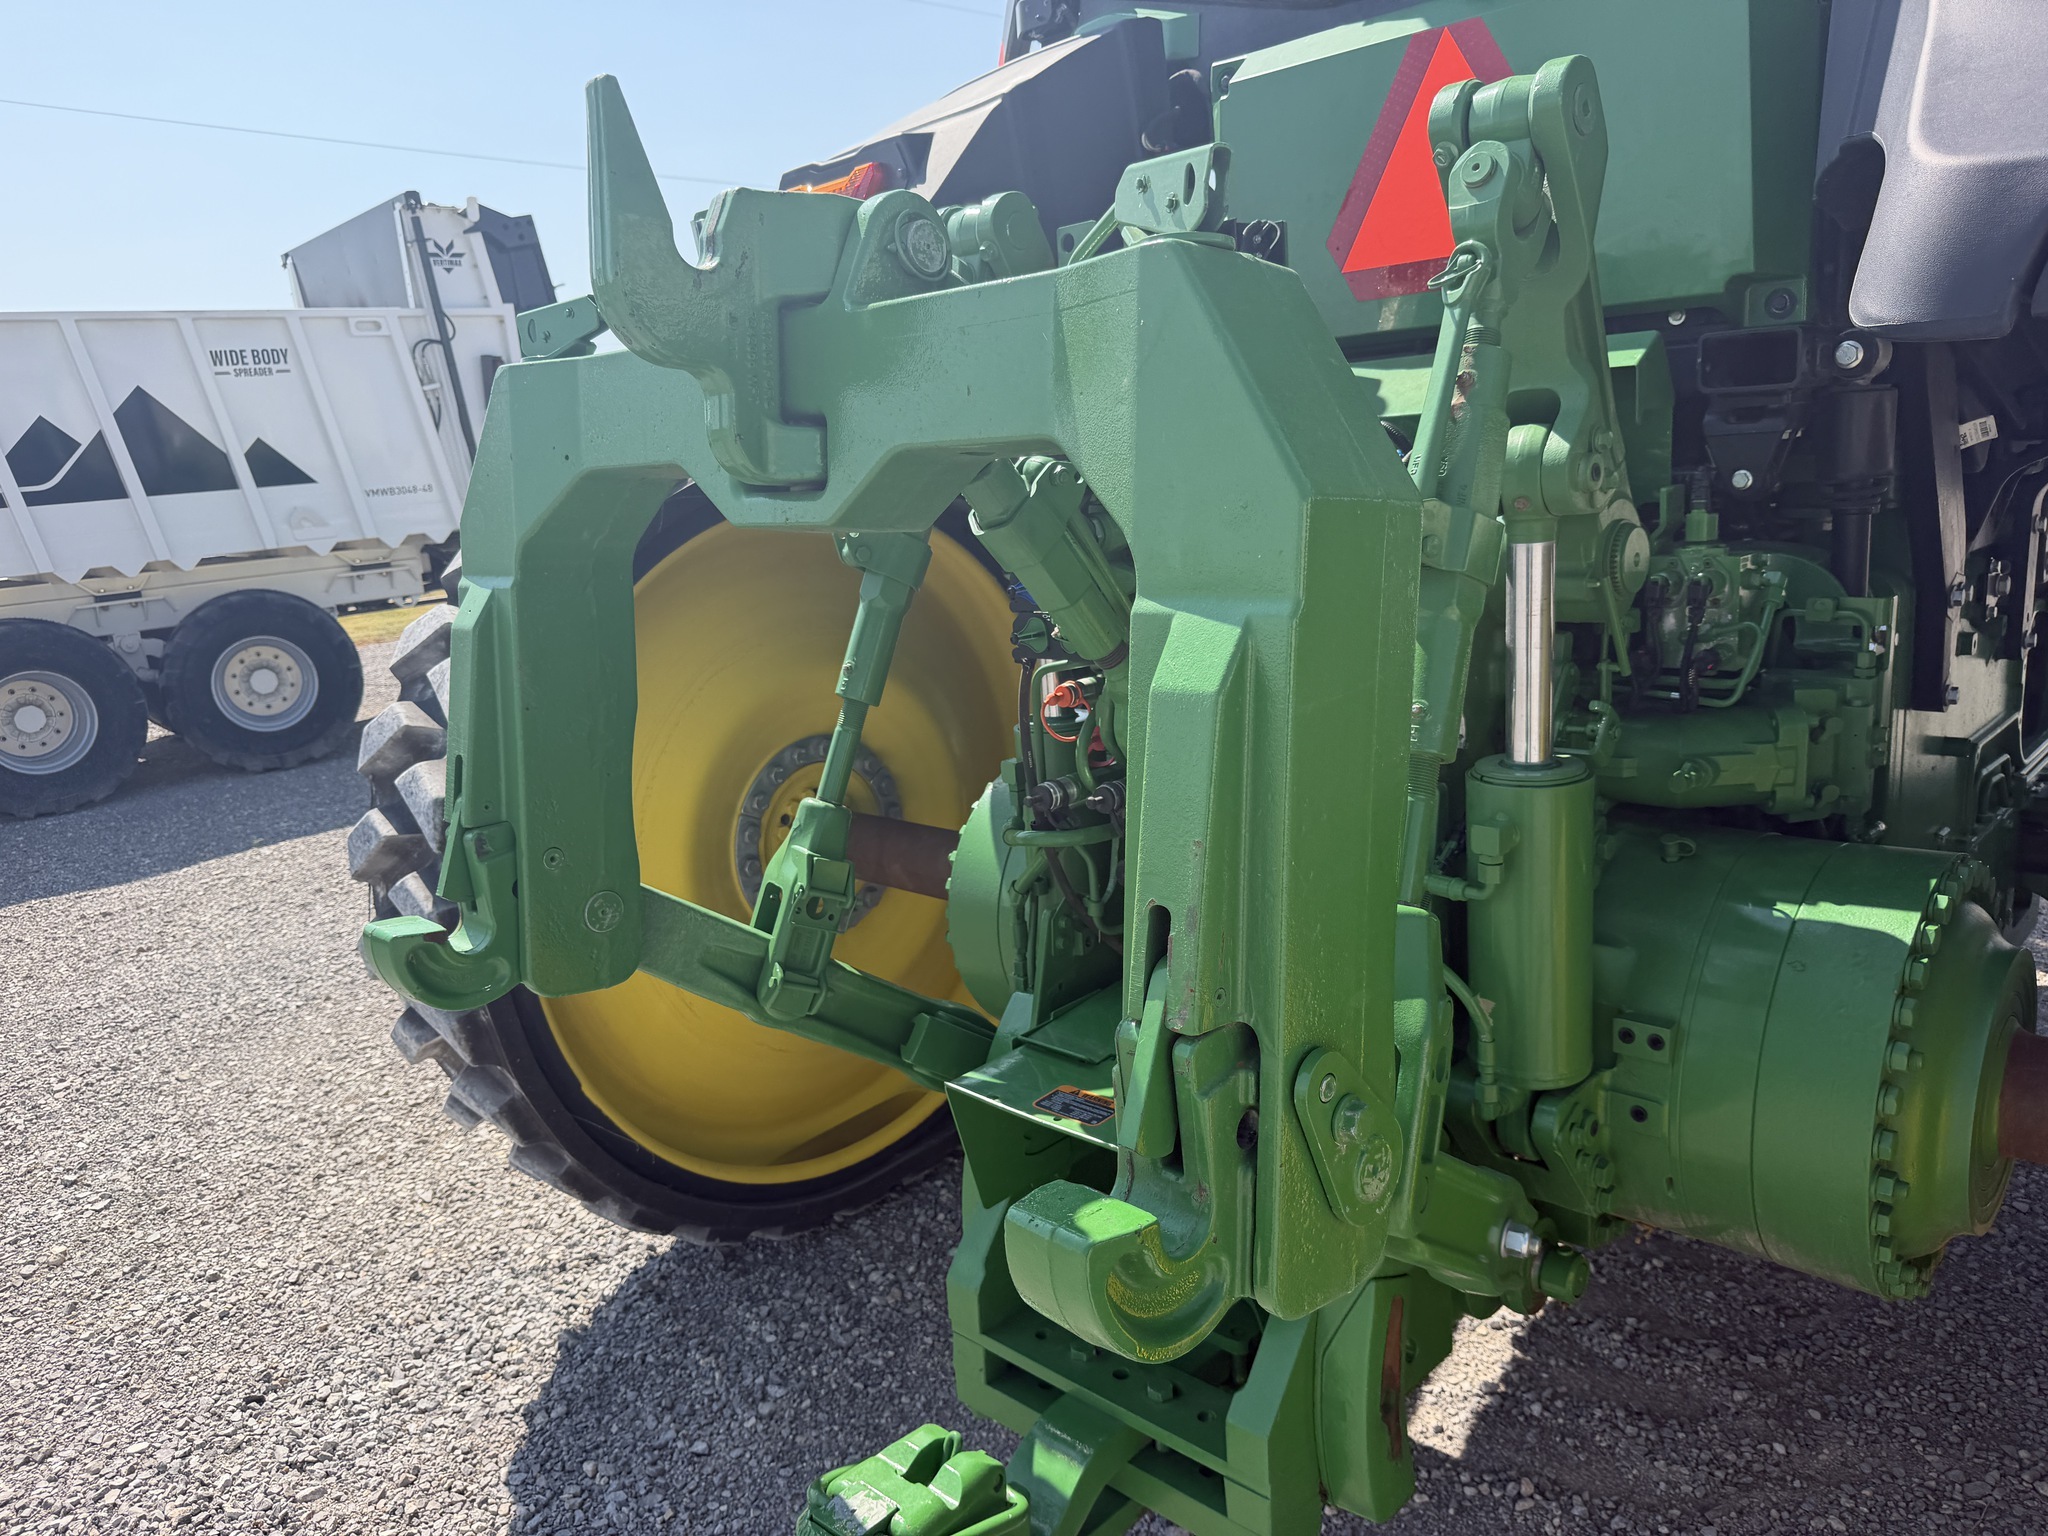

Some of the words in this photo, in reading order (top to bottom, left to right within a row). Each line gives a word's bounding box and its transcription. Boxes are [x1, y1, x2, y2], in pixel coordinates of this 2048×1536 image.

[209, 349, 249, 367] WIDE
[251, 348, 288, 366] BODY
[233, 367, 274, 377] SPREADER
